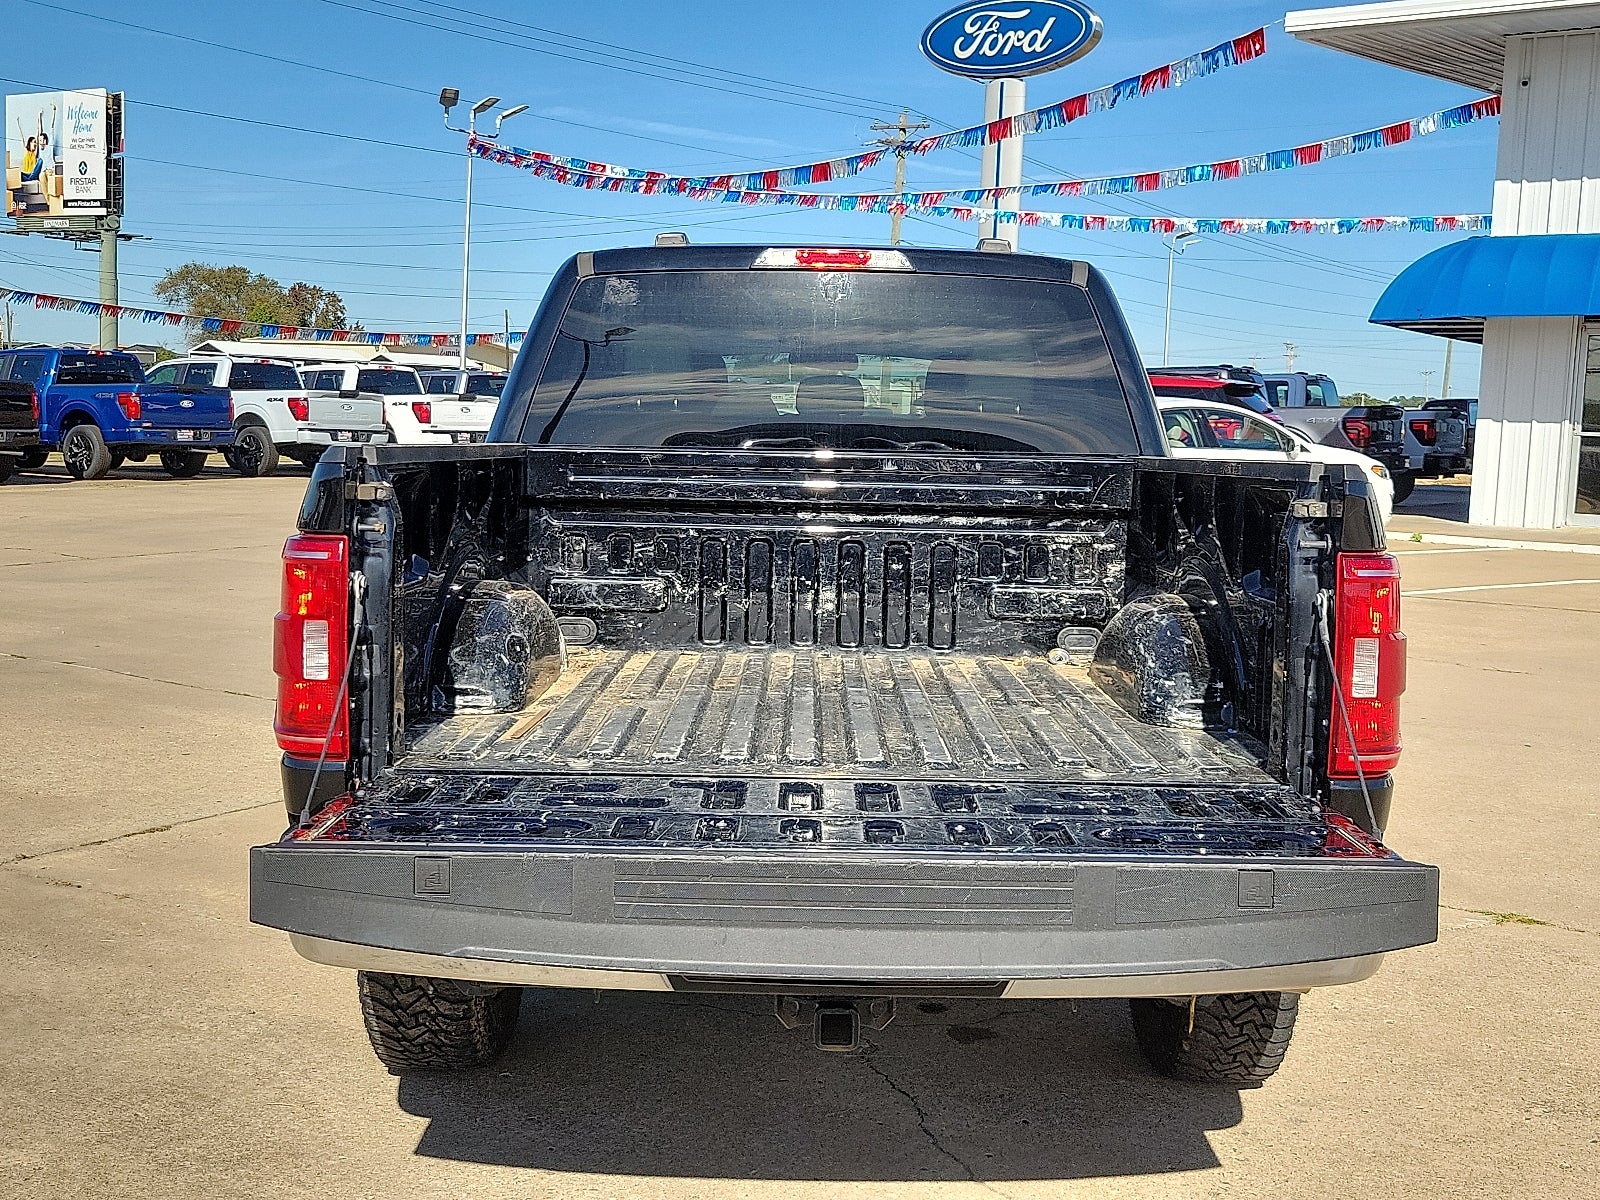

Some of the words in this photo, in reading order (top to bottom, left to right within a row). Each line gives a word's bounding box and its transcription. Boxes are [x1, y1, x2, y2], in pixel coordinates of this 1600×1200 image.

[953, 8, 1057, 59] Ford
[67, 101, 99, 120] Welcome
[73, 120, 93, 135] Home
[70, 177, 97, 186] FIRSTAR
[75, 186, 92, 194] BANK
